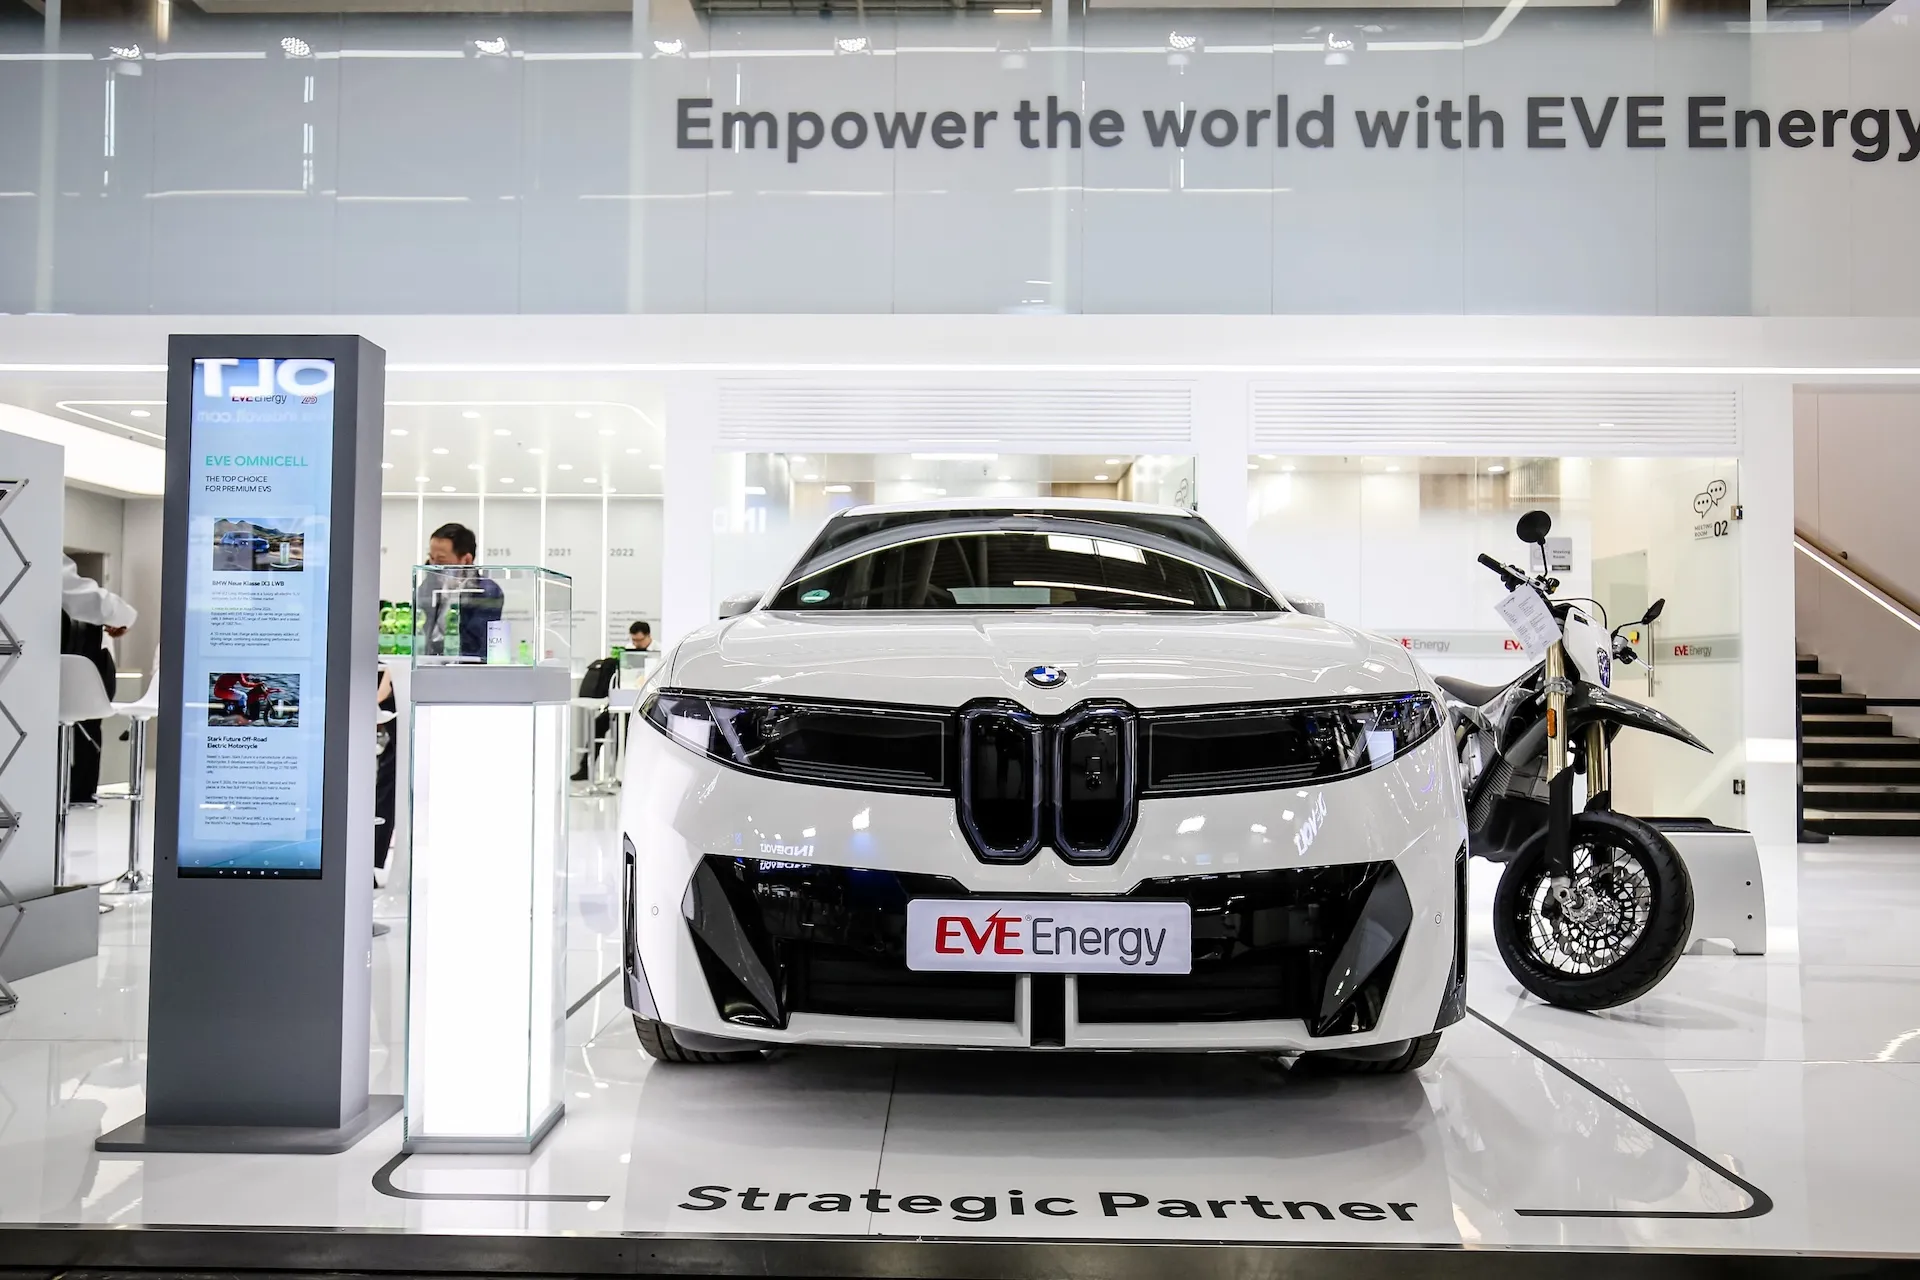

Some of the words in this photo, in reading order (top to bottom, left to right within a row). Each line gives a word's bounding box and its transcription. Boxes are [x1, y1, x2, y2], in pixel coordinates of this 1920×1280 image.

[676, 97, 998, 164] Empower
[1013, 95, 1125, 150] the
[1142, 94, 1335, 150] world
[1354, 94, 1504, 150] with
[1527, 95, 1667, 150] EVE
[1687, 95, 1920, 163] Energy
[205, 455, 231, 466] EVE
[234, 455, 308, 467] OMNICELL
[237, 475, 268, 483] CHOICE
[222, 485, 257, 493] PREMIUM
[258, 485, 272, 493] EVS
[1714, 520, 1729, 537] 02
[547, 547, 572, 557] 2021
[609, 547, 635, 557] 2022
[1413, 638, 1451, 653] Energy
[1504, 639, 1523, 651] EV
[1674, 645, 1689, 656] EVE
[1689, 645, 1713, 658] Energy
[935, 909, 1023, 955] EVE
[1033, 917, 1167, 966] Energy
[677, 1184, 1079, 1223] Strategic
[1098, 1191, 1418, 1222] Partner
